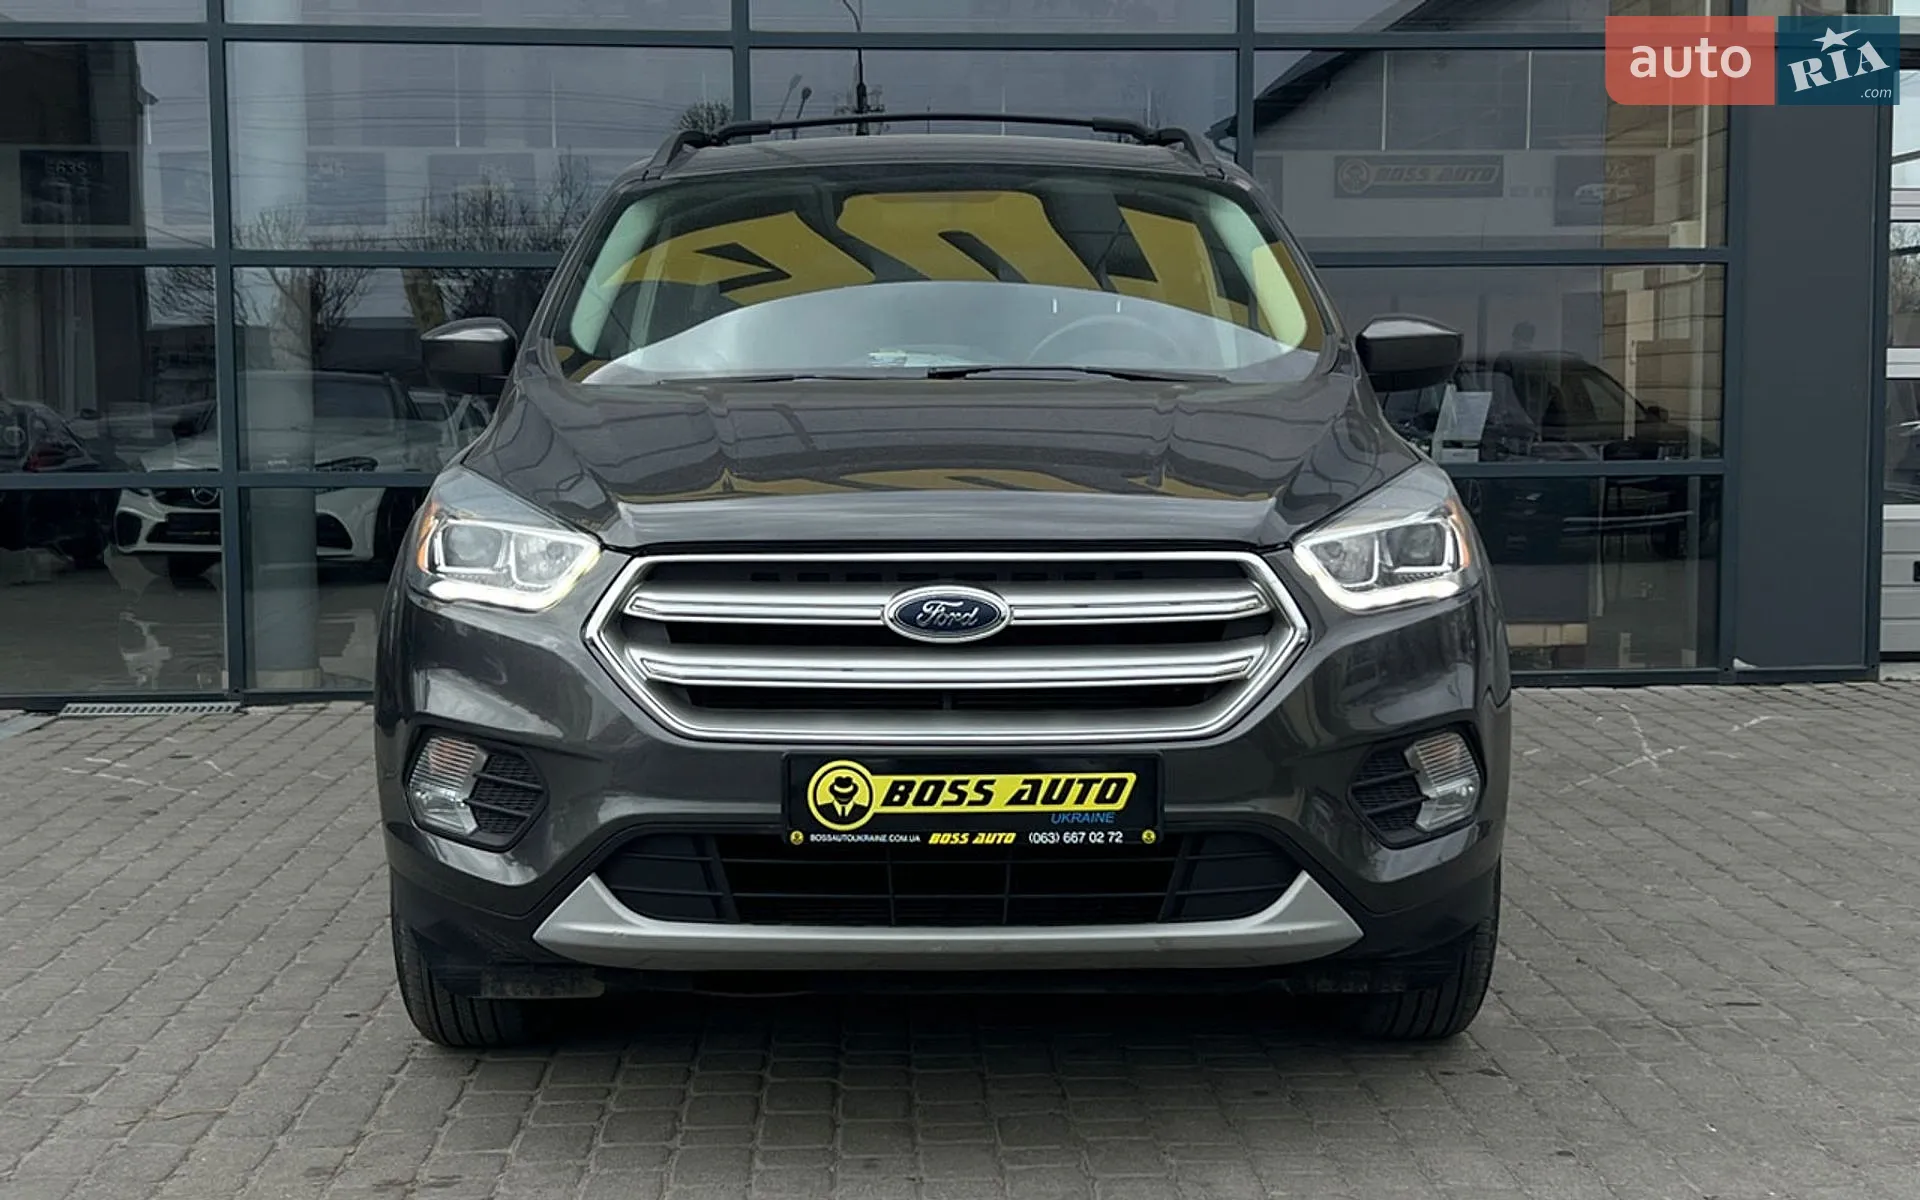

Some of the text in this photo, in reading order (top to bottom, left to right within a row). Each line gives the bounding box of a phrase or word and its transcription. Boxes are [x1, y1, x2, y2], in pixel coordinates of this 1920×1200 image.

[1373, 166, 1495, 181] BOSS AUTO
[915, 600, 979, 626] Ford
[880, 777, 1129, 807] BOSS AUTO
[1050, 811, 1116, 824] UKRAINE
[928, 832, 1017, 845] BOSS AUTO
[1028, 831, 1124, 845] (063) 667 02 72
